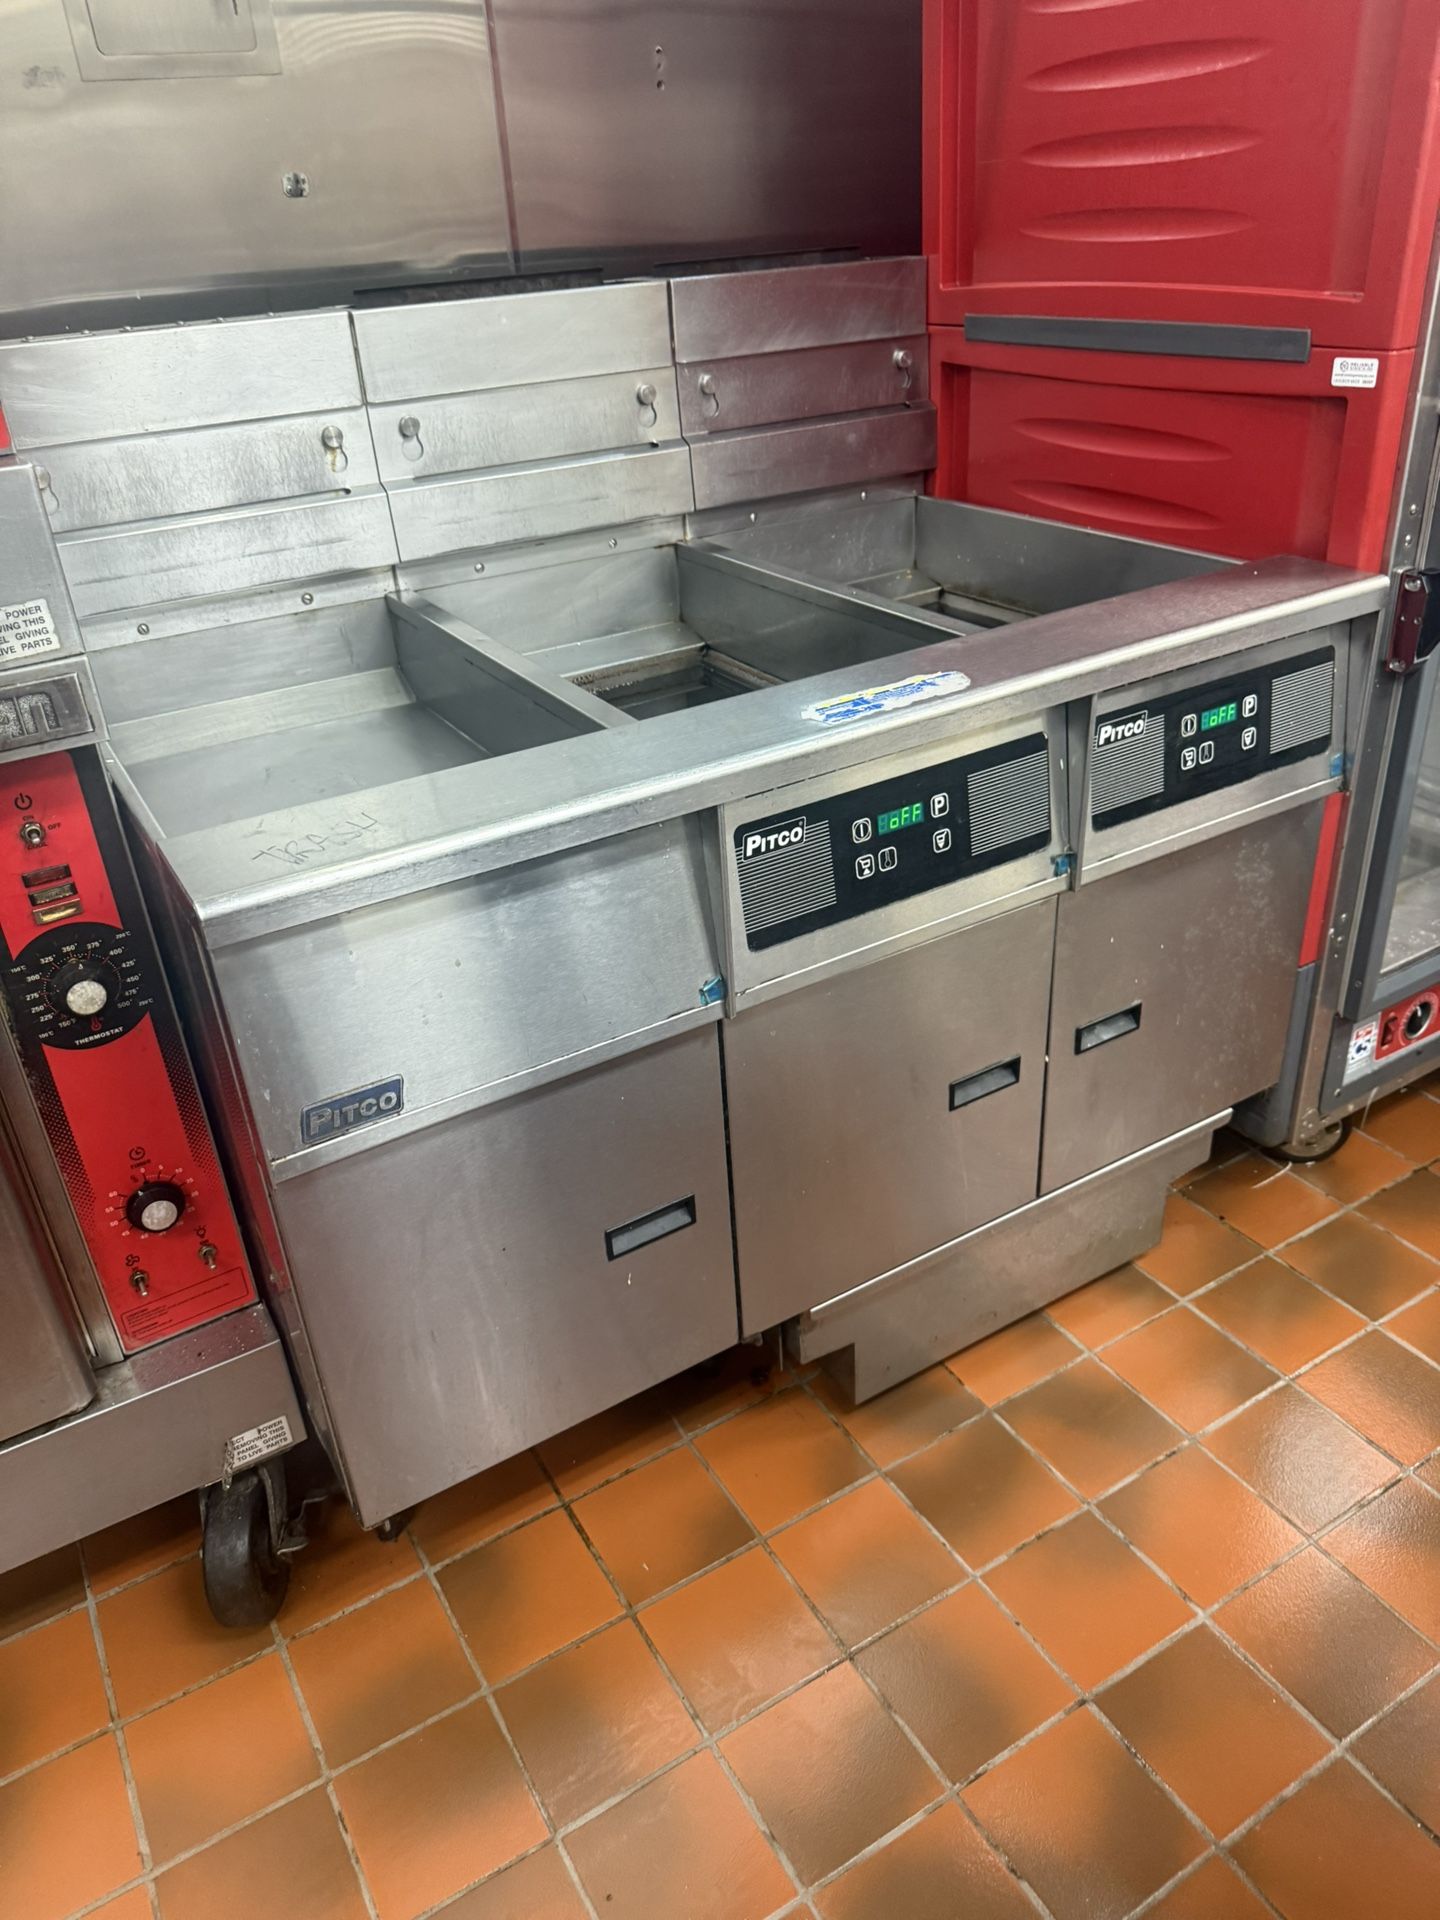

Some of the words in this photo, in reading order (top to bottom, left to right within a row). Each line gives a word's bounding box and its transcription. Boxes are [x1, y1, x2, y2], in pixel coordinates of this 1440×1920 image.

[5, 606, 42, 620] POWER
[0, 621, 21, 632] ING
[22, 616, 46, 628] THIS
[15, 627, 49, 641] GIVING
[20, 637, 53, 651] PARTS
[1099, 719, 1144, 746] PITCO
[934, 796, 945, 816] P
[746, 826, 803, 857] PITCO
[75, 1026, 124, 1046] THERMOSTAT
[309, 1091, 398, 1137] PITCO
[237, 1443, 260, 1456] PANEL
[262, 1430, 287, 1445] GIVING
[237, 1454, 248, 1462] TO
[248, 1447, 263, 1458] LIVE
